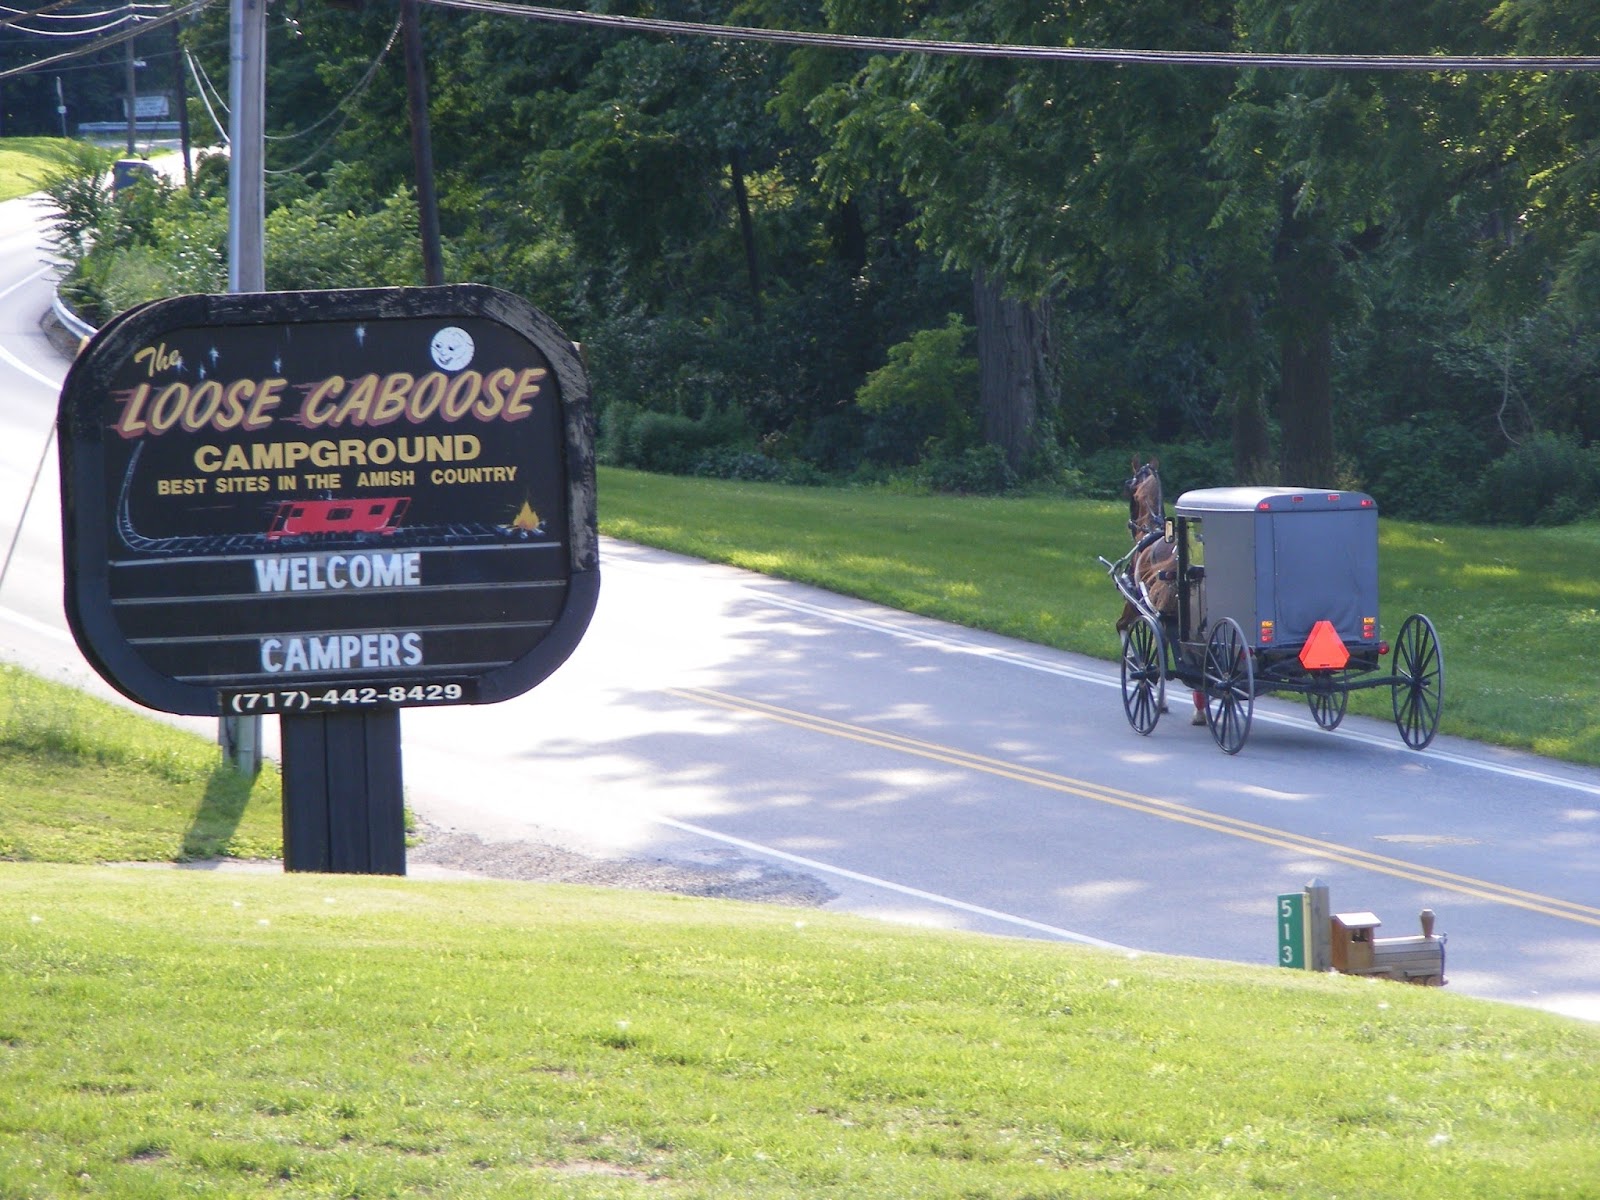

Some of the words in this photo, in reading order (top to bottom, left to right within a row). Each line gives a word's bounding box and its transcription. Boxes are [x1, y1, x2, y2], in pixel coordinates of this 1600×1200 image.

[134, 343, 181, 377] The
[119, 378, 288, 438] LOOSE
[300, 368, 547, 427] CABOOSE
[194, 435, 481, 473] CAMPGROUND
[157, 478, 207, 495] BEST
[215, 476, 270, 493] SITES
[277, 475, 296, 490] IN
[304, 473, 342, 489] THE
[357, 470, 415, 487] AMISH
[431, 466, 517, 484] COUNTRY
[255, 553, 421, 592] WELCOME
[261, 632, 423, 673] CAMPERS
[232, 683, 462, 712] (717)-442-8429
[1281, 899, 1293, 963] 513
